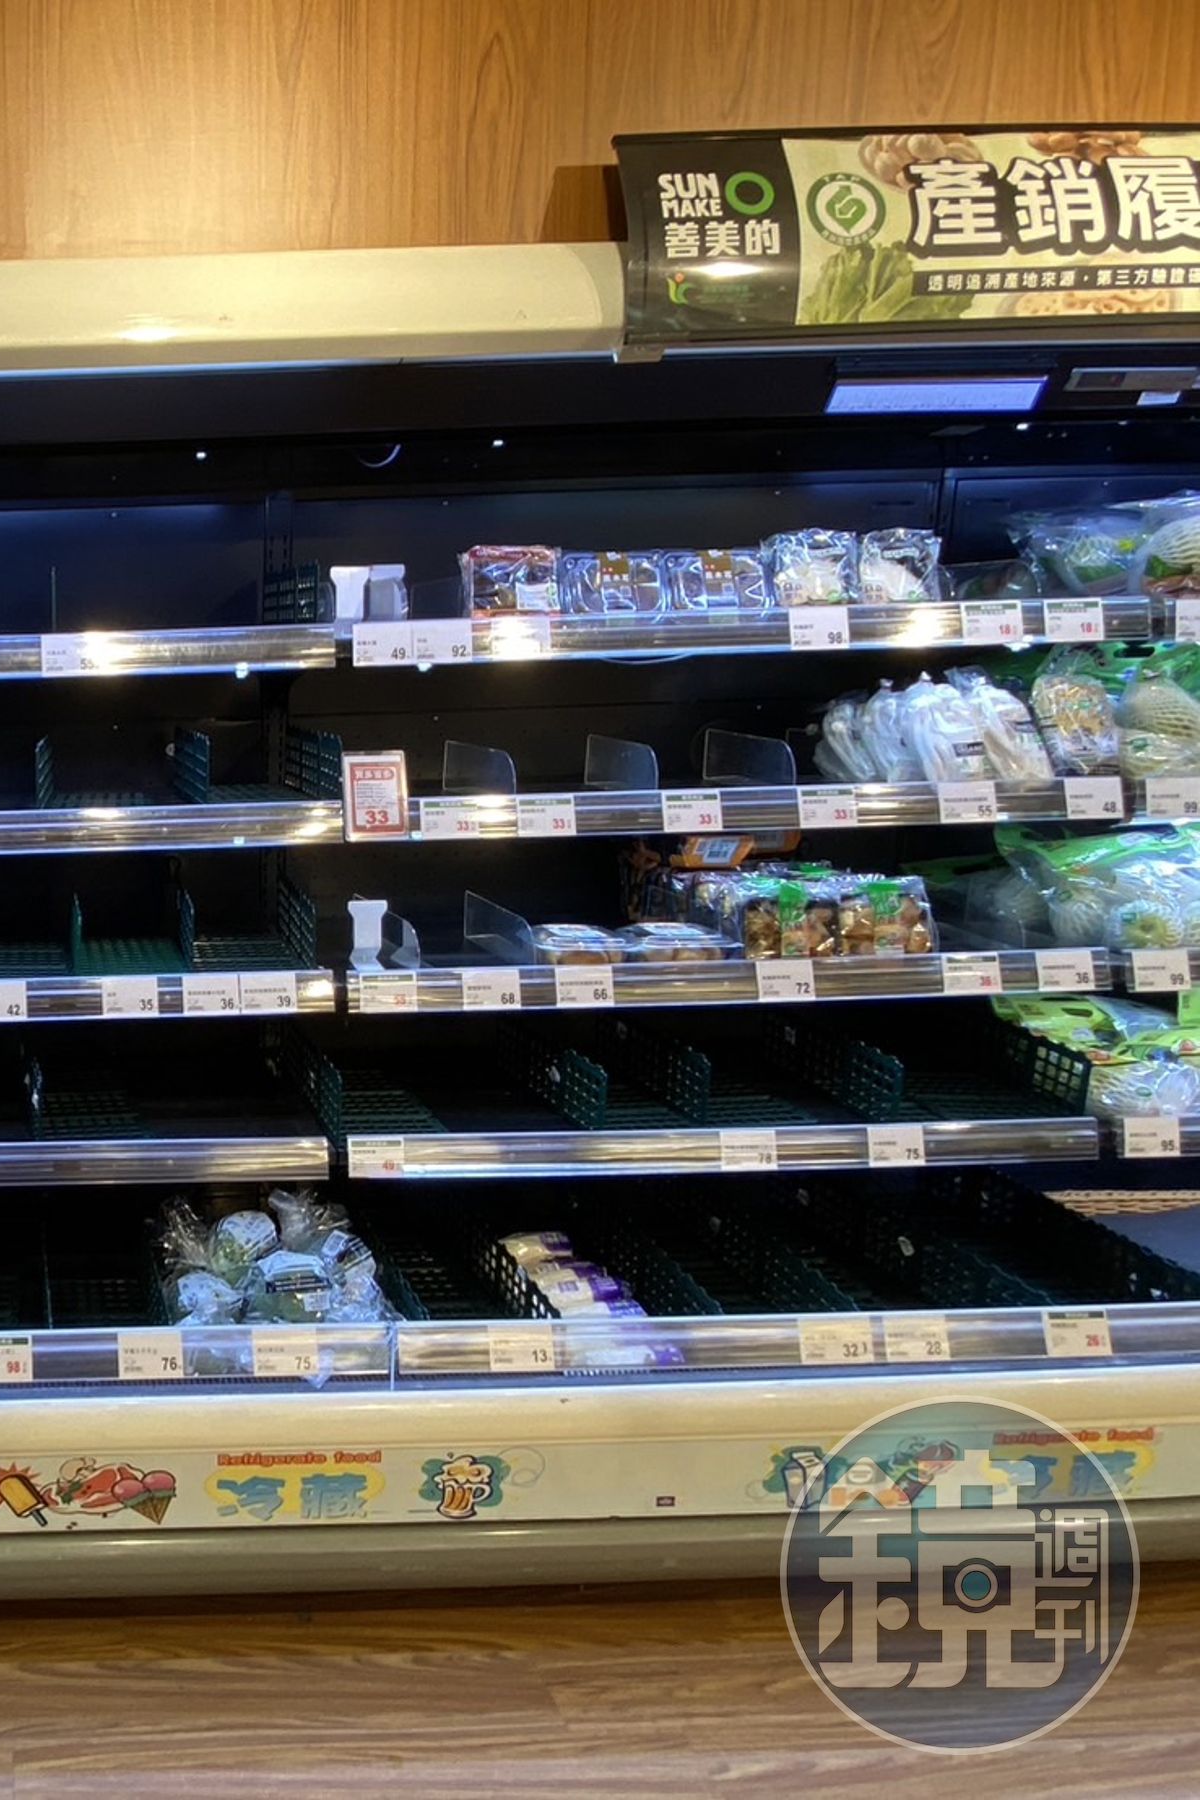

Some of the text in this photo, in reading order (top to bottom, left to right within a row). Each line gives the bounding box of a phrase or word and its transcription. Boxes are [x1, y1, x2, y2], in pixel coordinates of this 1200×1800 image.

[658, 173, 718, 198] SUN
[910, 158, 1200, 247] 產銷履
[661, 200, 722, 218] MAKE
[664, 218, 780, 258] 善美的
[828, 632, 842, 644] 98
[391, 647, 406, 659] 49
[452, 645, 466, 657] 92
[978, 806, 992, 816] 55
[1102, 802, 1116, 812] 48
[365, 810, 389, 824] 33
[552, 818, 565, 828] 33
[456, 821, 469, 831] 33
[1076, 972, 1089, 984] 36
[594, 988, 608, 1000] 66
[796, 982, 810, 994] 72
[220, 998, 234, 1010] 36
[277, 996, 290, 1008] 39
[501, 993, 515, 1004] 68
[6, 1004, 21, 1016] 42
[140, 1000, 152, 1011] 35
[1161, 1140, 1174, 1152] 95
[906, 1148, 920, 1160] 75
[532, 1350, 548, 1362] 13
[843, 1344, 858, 1357] 32
[7, 1361, 20, 1374] 98
[162, 1357, 178, 1371] 76
[296, 1356, 310, 1370] 75
[334, 1450, 382, 1463] food
[217, 1472, 368, 1522] 冷藏
